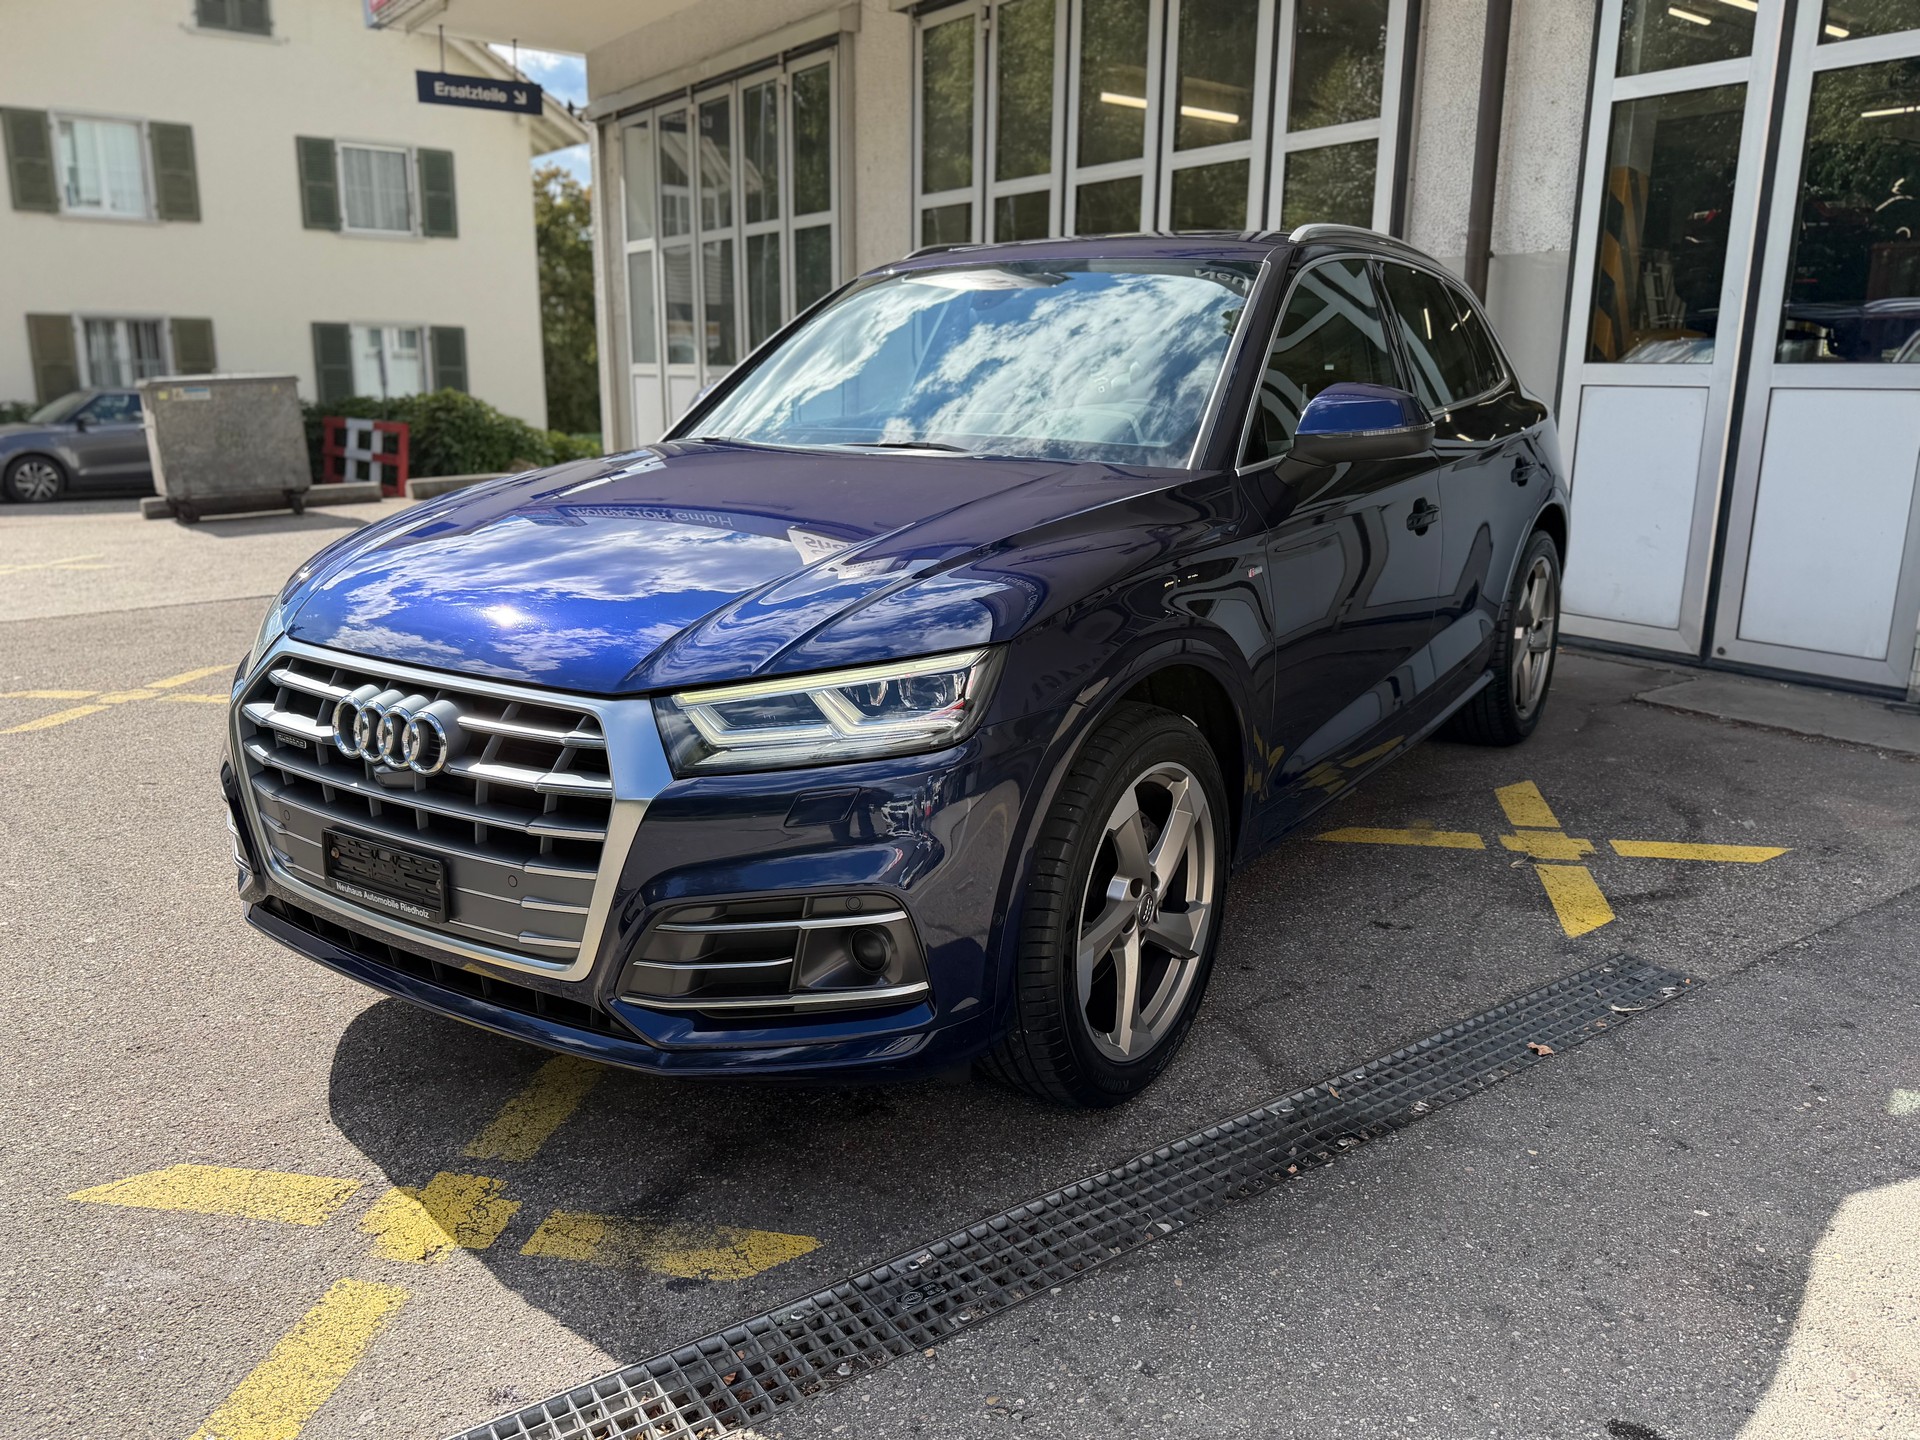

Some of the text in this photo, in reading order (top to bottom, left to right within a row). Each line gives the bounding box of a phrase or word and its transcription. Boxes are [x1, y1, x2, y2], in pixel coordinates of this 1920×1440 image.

[434, 80, 508, 103] Ersatzteile
[336, 881, 430, 919] Neuhaus Automobile Riedholz
